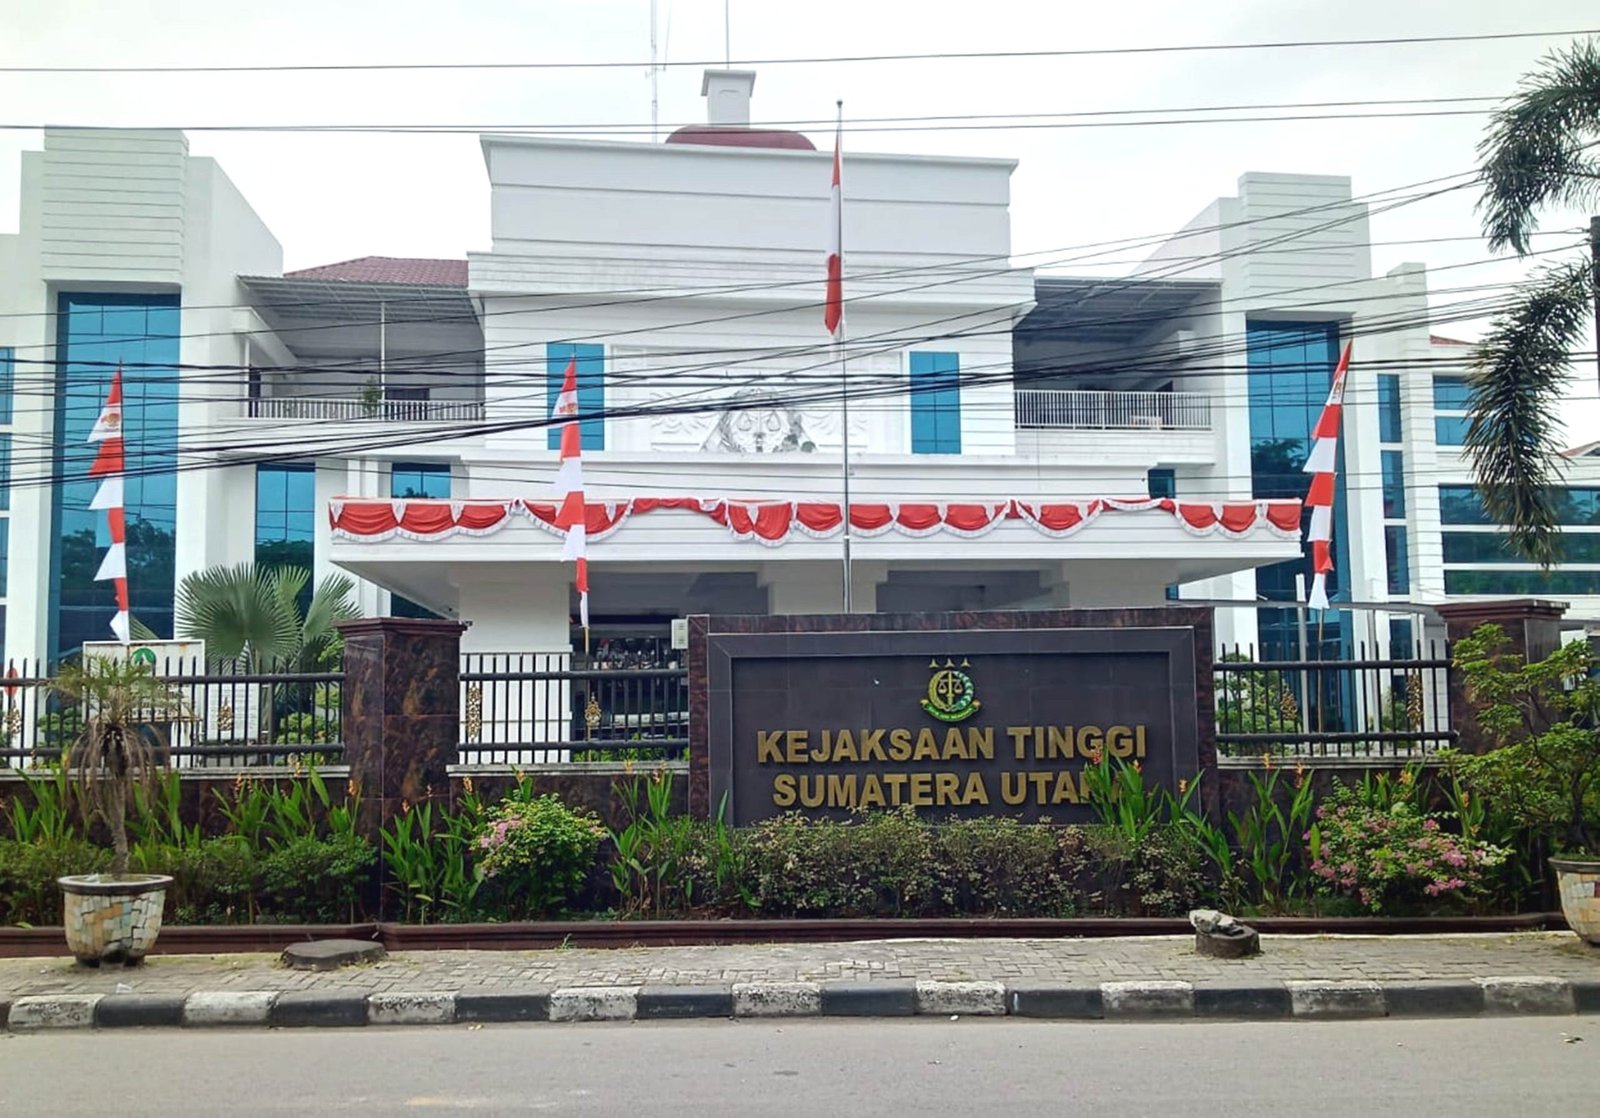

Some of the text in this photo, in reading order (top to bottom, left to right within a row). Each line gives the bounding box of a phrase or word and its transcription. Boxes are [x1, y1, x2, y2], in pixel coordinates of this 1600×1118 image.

[757, 725, 1146, 763] KEJAKSAAN TINGGI
[773, 771, 1125, 807] SUMATERA UTA
